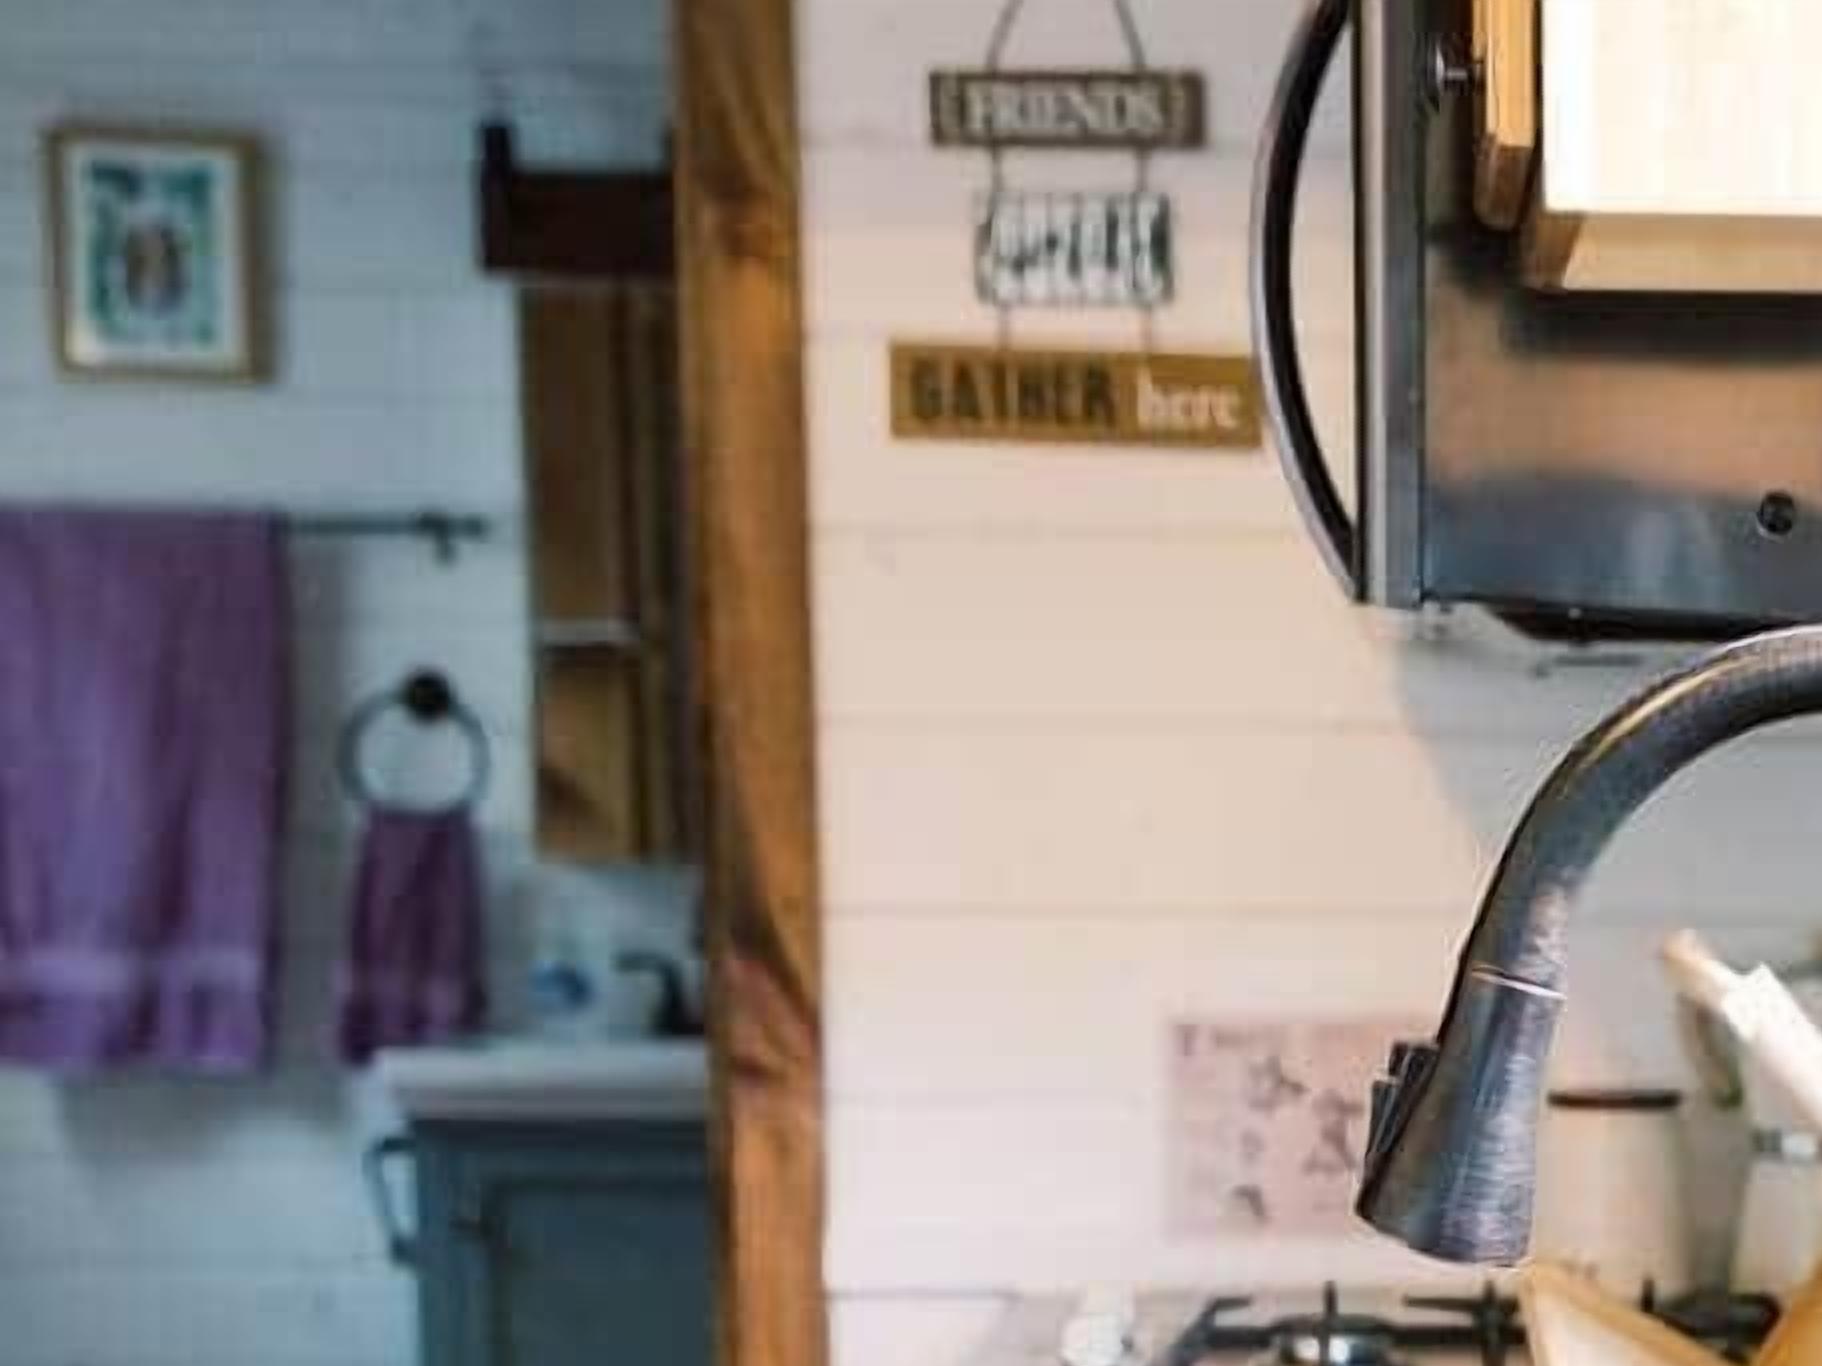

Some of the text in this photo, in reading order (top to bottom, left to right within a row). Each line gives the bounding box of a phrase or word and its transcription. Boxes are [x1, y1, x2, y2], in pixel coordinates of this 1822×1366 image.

[965, 80, 1166, 132] FRIENDS
[910, 356, 1246, 430] GATHER here
